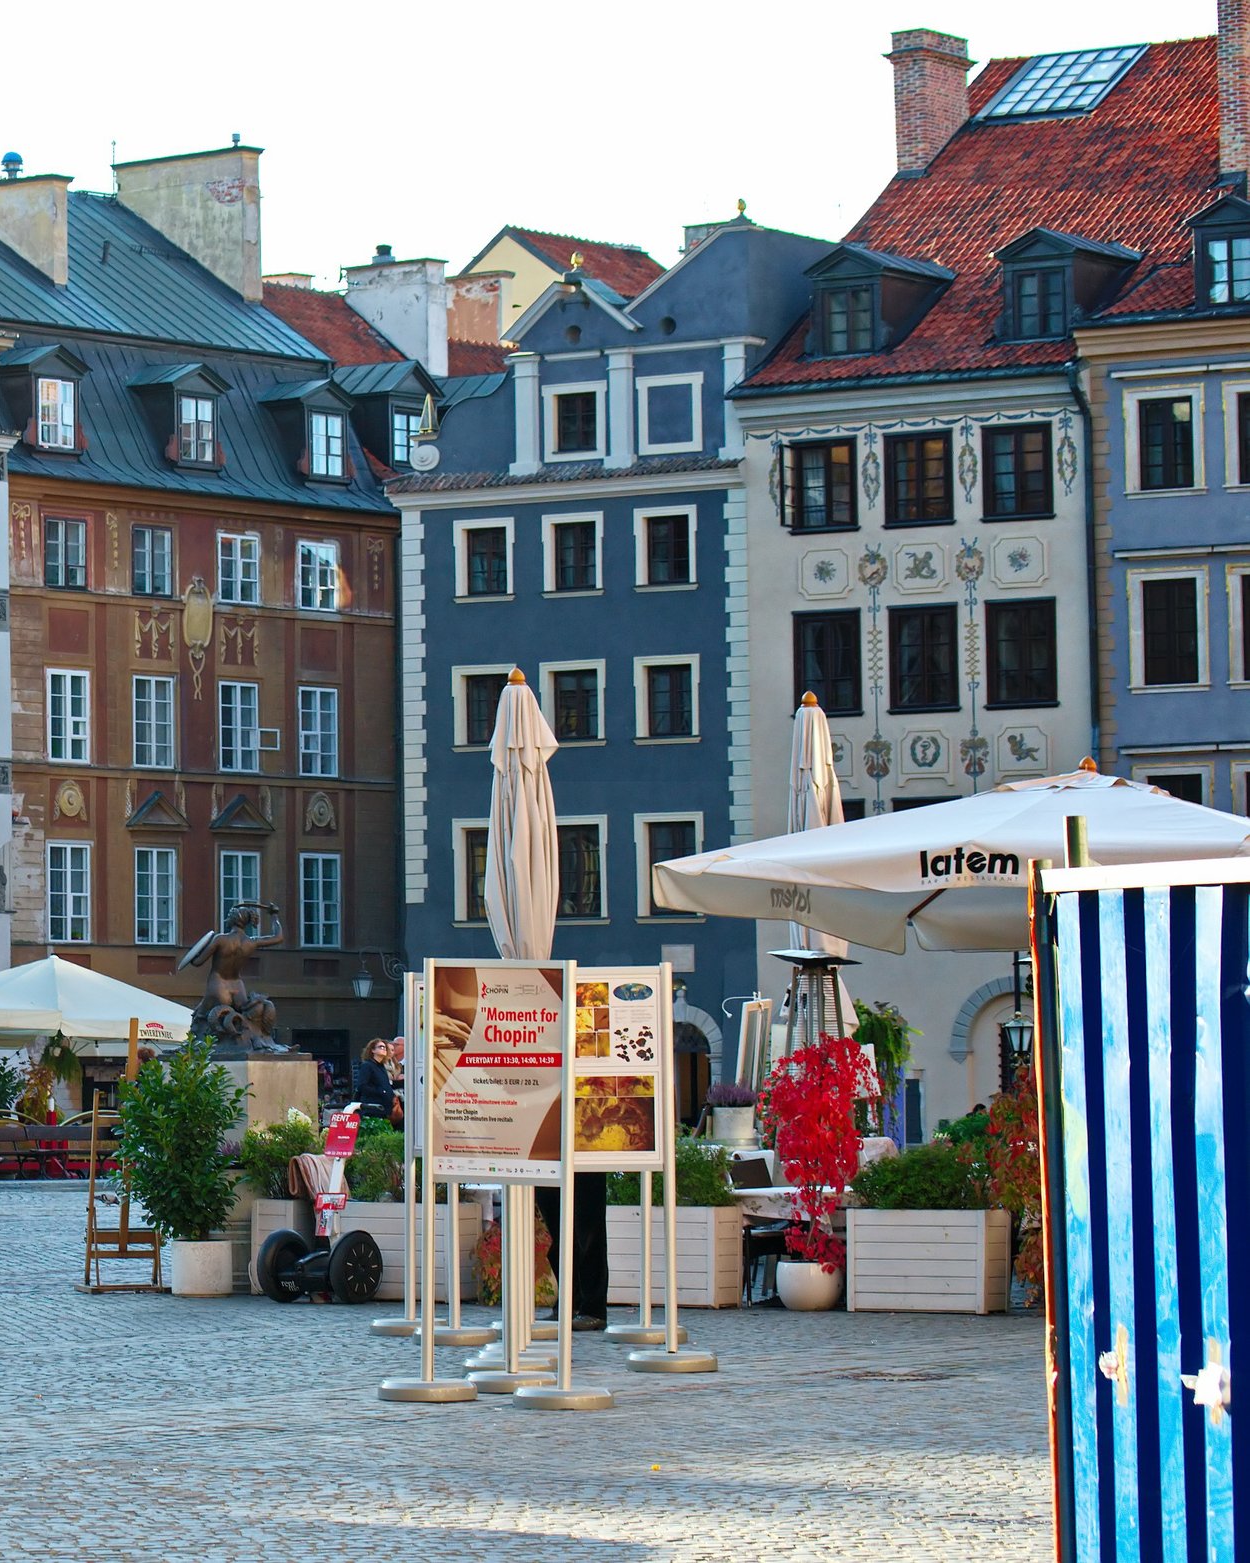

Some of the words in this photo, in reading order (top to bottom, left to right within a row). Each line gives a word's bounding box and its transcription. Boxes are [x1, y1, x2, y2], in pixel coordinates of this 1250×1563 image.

[920, 847, 1019, 878] latem
[481, 1007, 538, 1022] "Moment
[540, 1008, 558, 1022] for
[484, 1025, 544, 1047] Chopin"
[331, 1114, 350, 1122] RENT
